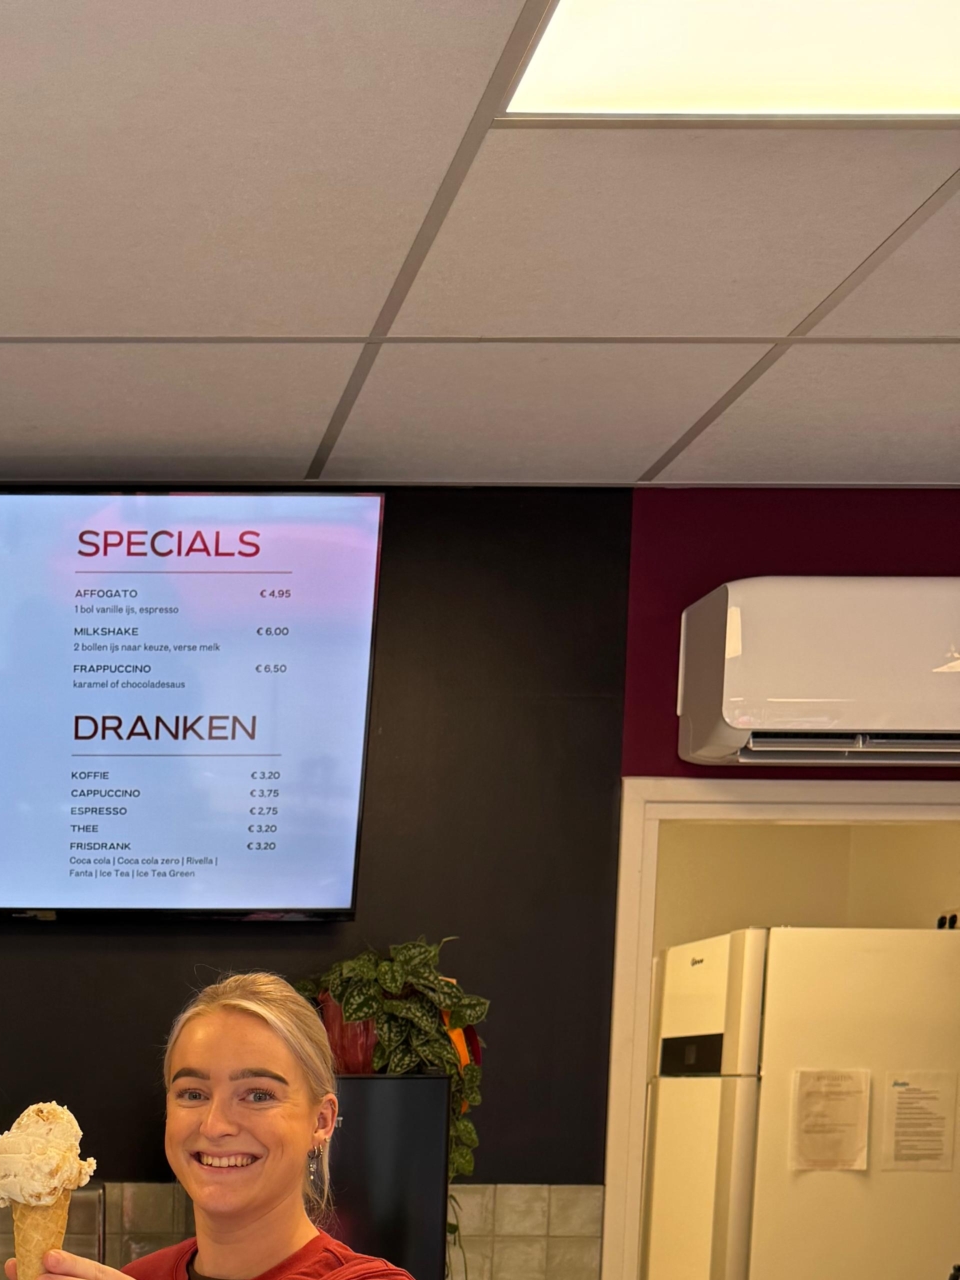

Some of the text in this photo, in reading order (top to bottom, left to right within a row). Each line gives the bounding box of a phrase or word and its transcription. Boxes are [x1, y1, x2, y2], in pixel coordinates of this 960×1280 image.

[78, 530, 260, 557] SPECIALS
[75, 589, 138, 598] AFFOGATO
[260, 589, 266, 598] €
[80, 605, 94, 614] bol
[96, 605, 123, 614] vanille
[139, 607, 179, 615] espresso
[74, 627, 138, 636] MILKSHAKE
[256, 627, 263, 636] €
[74, 643, 80, 651] 2
[81, 643, 108, 651] bollen
[110, 643, 119, 653] ijs
[144, 643, 171, 653] keuze,
[199, 643, 220, 651] melk
[74, 665, 151, 673] FRAPPUCCINO
[255, 664, 262, 673] €
[73, 680, 185, 688] karamel of chocoladesaus
[74, 715, 256, 740] DRANKEN
[71, 771, 109, 780] KOFFIE
[251, 771, 257, 779] €
[71, 789, 140, 797] CAPPUCCINO
[250, 789, 256, 797] €
[71, 807, 127, 815] ESPRESSO
[249, 807, 256, 815] €
[248, 825, 254, 833] €
[70, 842, 131, 850] FRISDRANK
[247, 842, 253, 850] €
[69, 856, 91, 865] Coca
[93, 856, 111, 865] cola
[117, 856, 139, 865] Coca
[141, 857, 159, 865] cola
[69, 869, 93, 877] Fanta
[99, 869, 112, 877] Ice
[114, 869, 130, 877] Tea
[136, 869, 149, 877] Ice
[151, 869, 167, 877] Tea
[169, 869, 195, 877] Green
